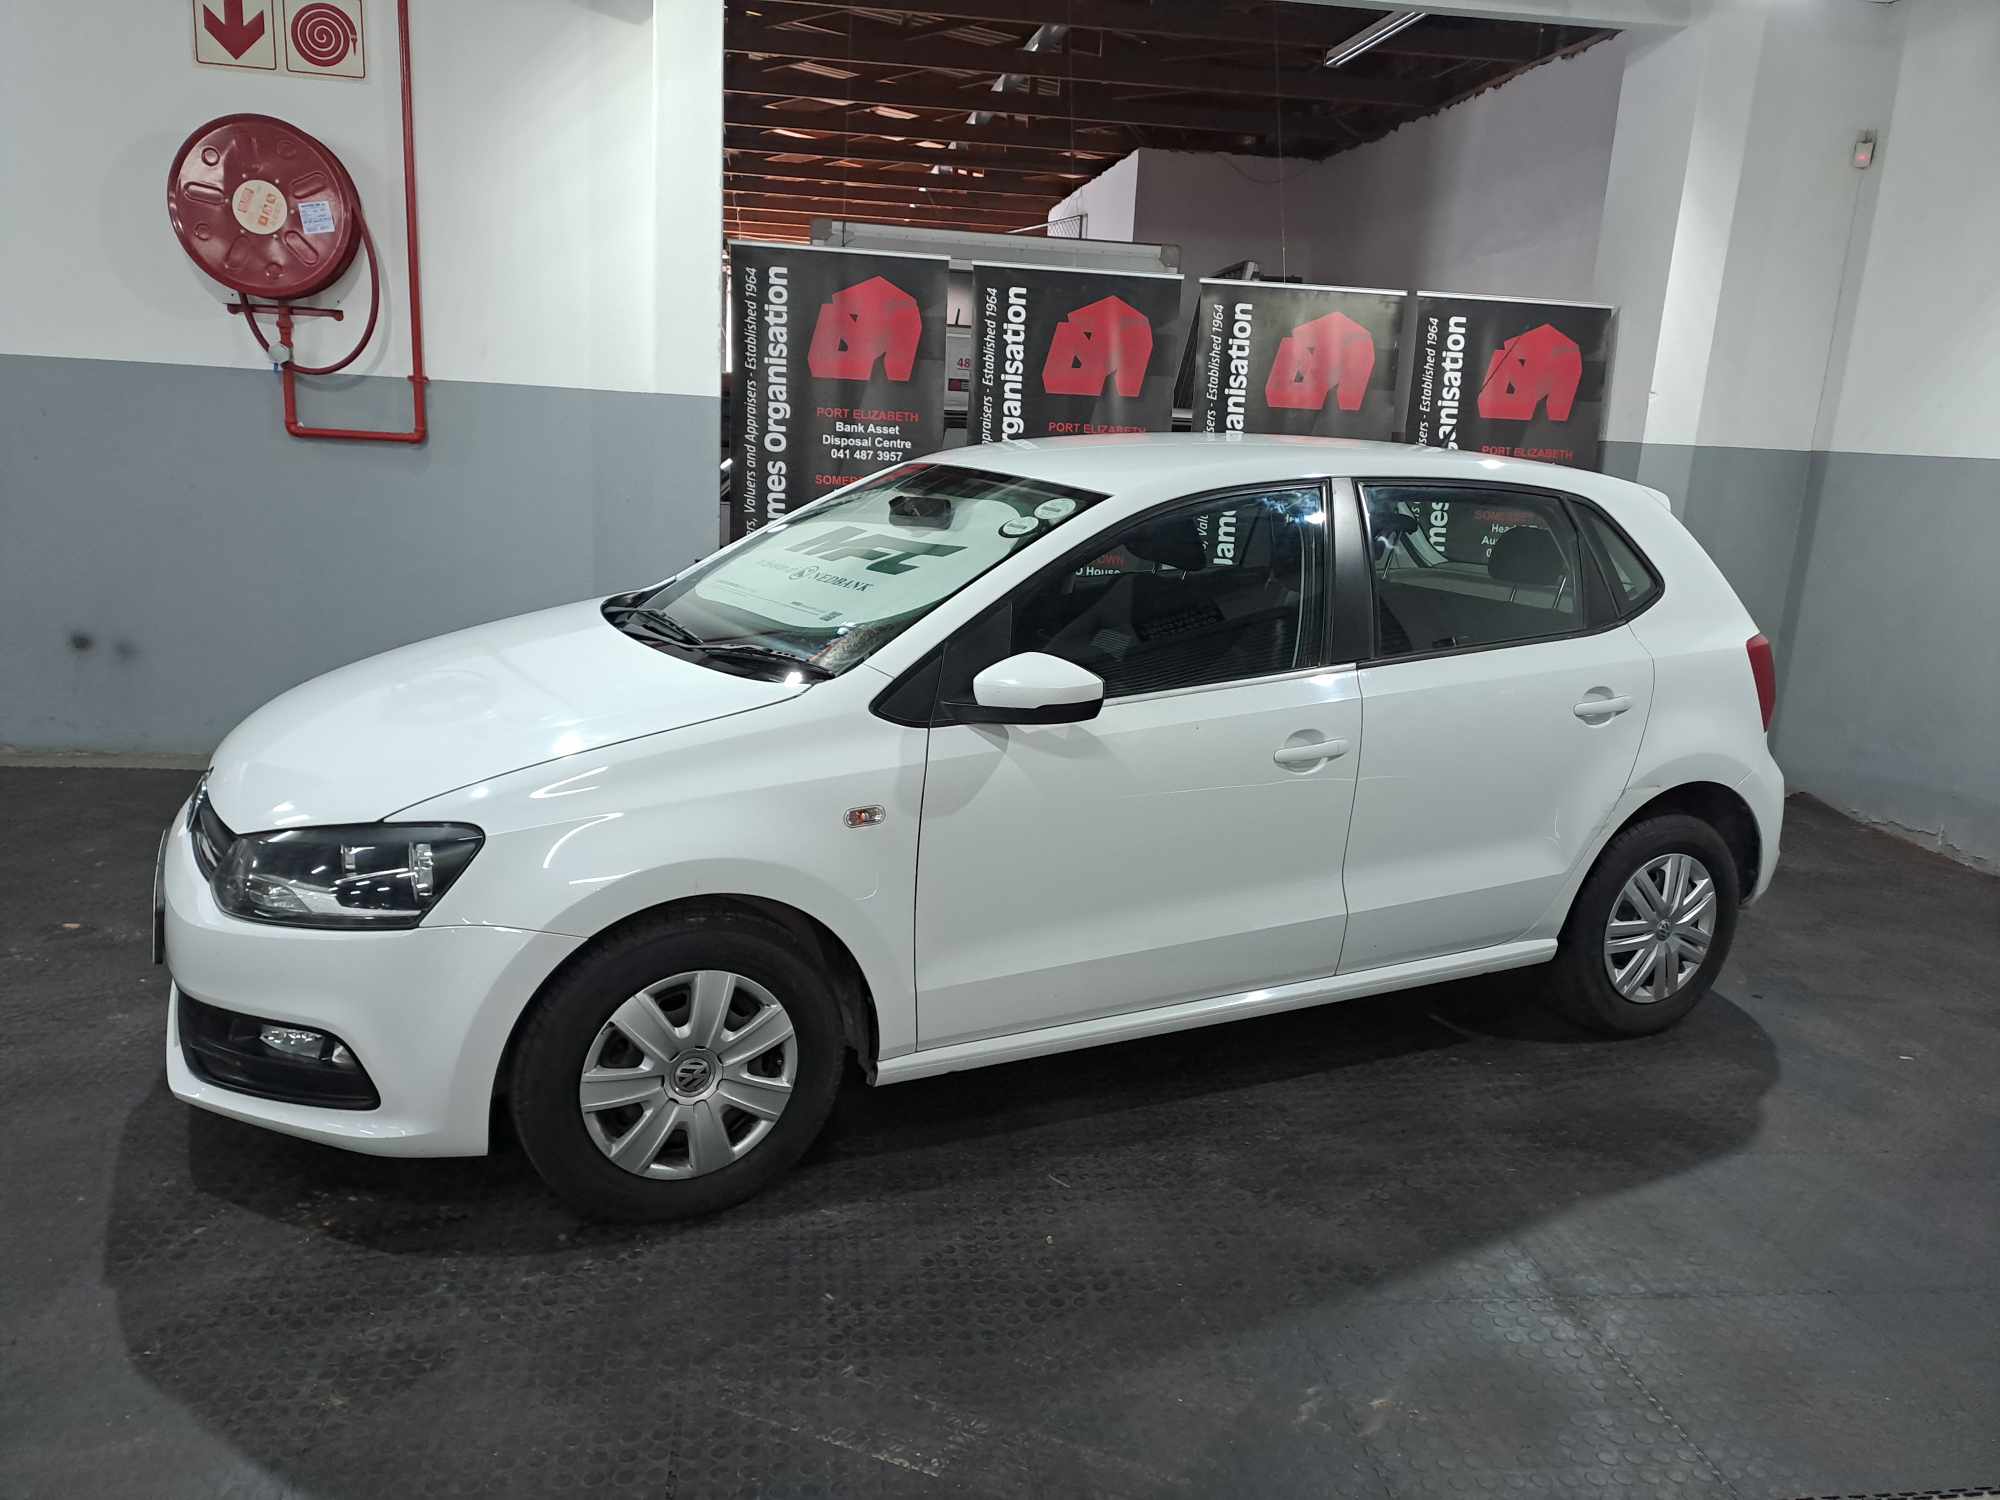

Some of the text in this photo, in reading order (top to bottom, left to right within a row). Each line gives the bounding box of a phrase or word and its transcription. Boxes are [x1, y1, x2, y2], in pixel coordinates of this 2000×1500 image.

[744, 266, 757, 297] 1964
[985, 287, 998, 317] 1964
[743, 300, 757, 370] Established
[1211, 303, 1225, 332] 1964
[1426, 316, 1439, 346] 1964
[981, 320, 996, 386] Established
[1000, 286, 1027, 443] rganisation
[1206, 334, 1222, 401] Established
[1224, 302, 1253, 434] anisation
[763, 266, 791, 523] mes Organisation
[1419, 347, 1436, 412] Established
[1437, 315, 1467, 450] anisation
[743, 380, 759, 442] Appraisers
[816, 407, 919, 422] PORT ELIZABETH
[835, 421, 900, 435] Bank Asset
[980, 395, 993, 444] praisers
[1048, 421, 1080, 433] PORT
[743, 444, 757, 468] and
[822, 434, 912, 449] Disposal Centre
[830, 448, 903, 462] 041 487 3957
[743, 470, 757, 513] Valuers
[815, 474, 864, 485] SOME
[1428, 501, 1450, 552] mes
